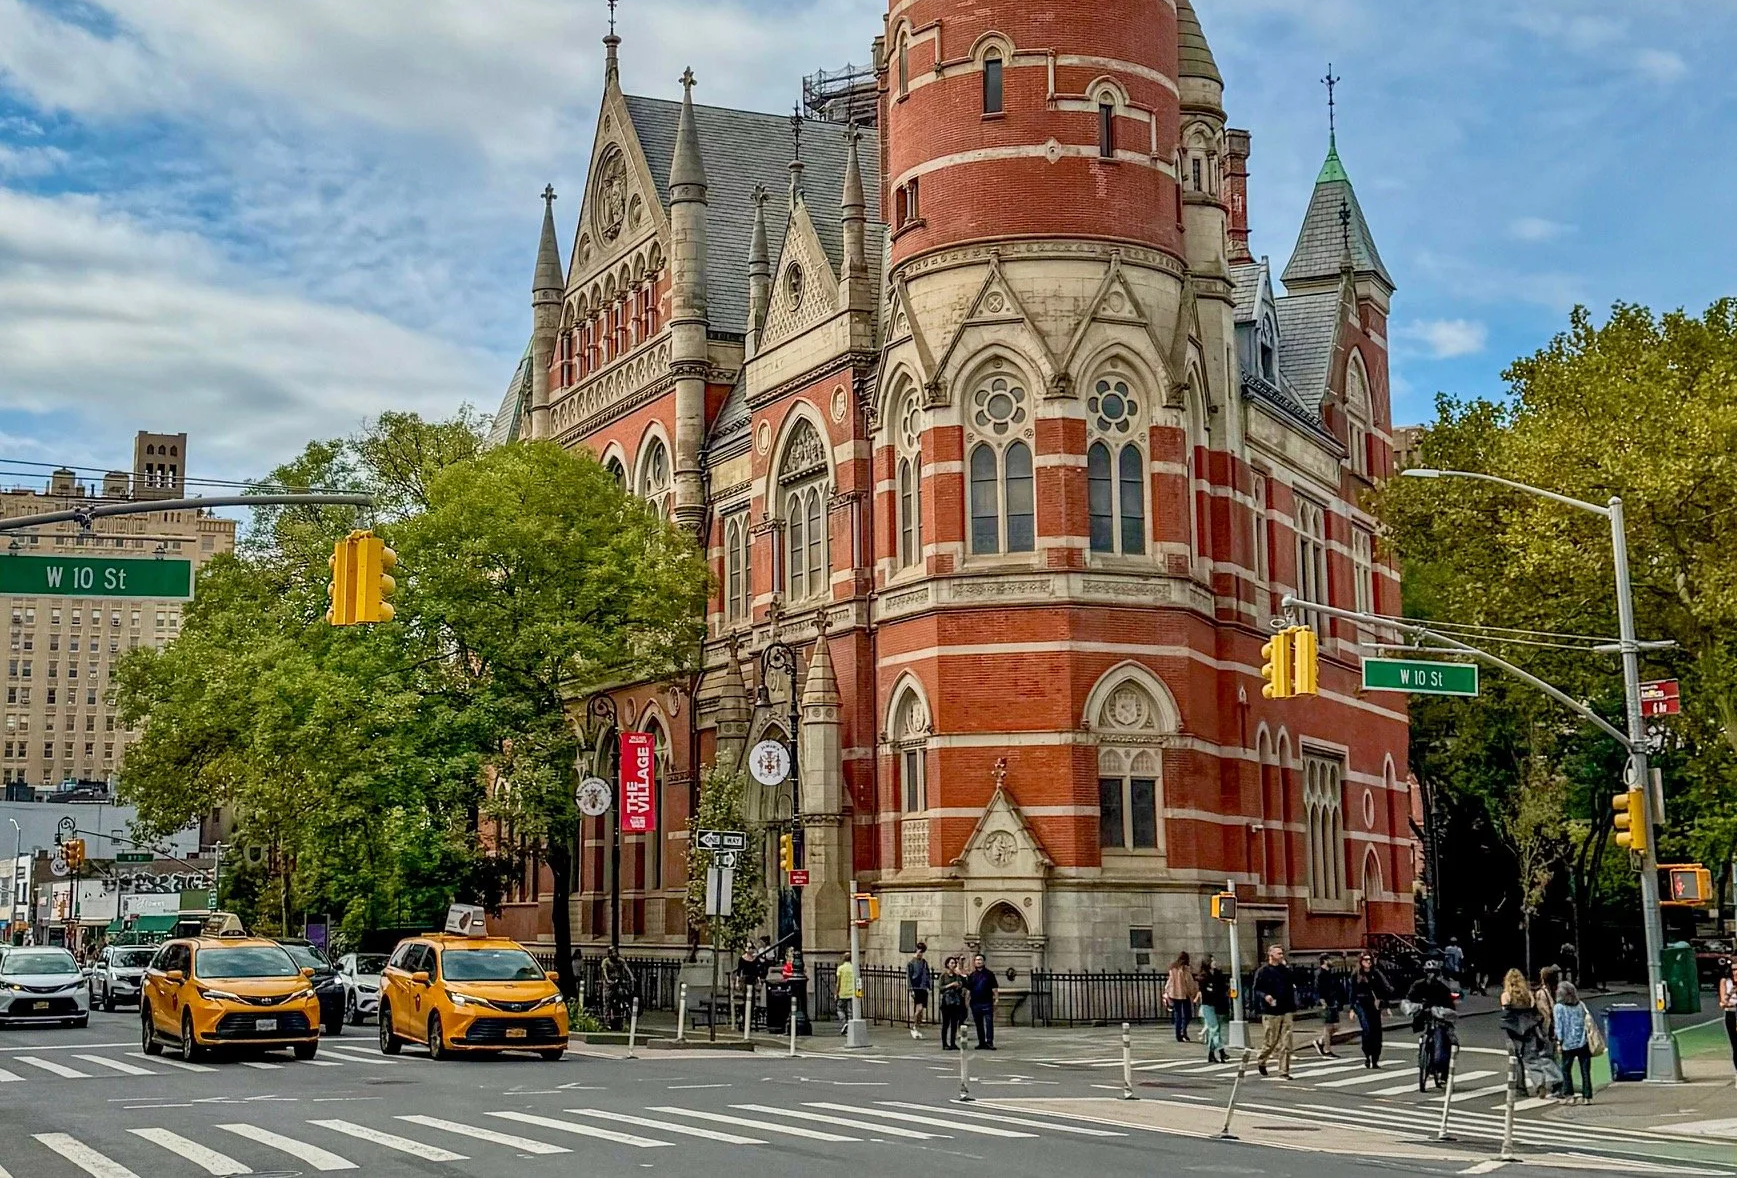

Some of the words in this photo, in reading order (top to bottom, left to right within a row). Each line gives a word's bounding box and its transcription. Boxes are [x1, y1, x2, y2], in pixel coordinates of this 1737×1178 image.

[46, 566, 63, 588] W
[73, 567, 94, 589] 10
[104, 567, 127, 590] St
[1400, 669, 1410, 685] W
[1414, 670, 1426, 686] 10
[1430, 671, 1443, 687] St
[637, 746, 650, 814] VILLAGE
[626, 781, 639, 814] THE
[705, 835, 719, 844] ONE
